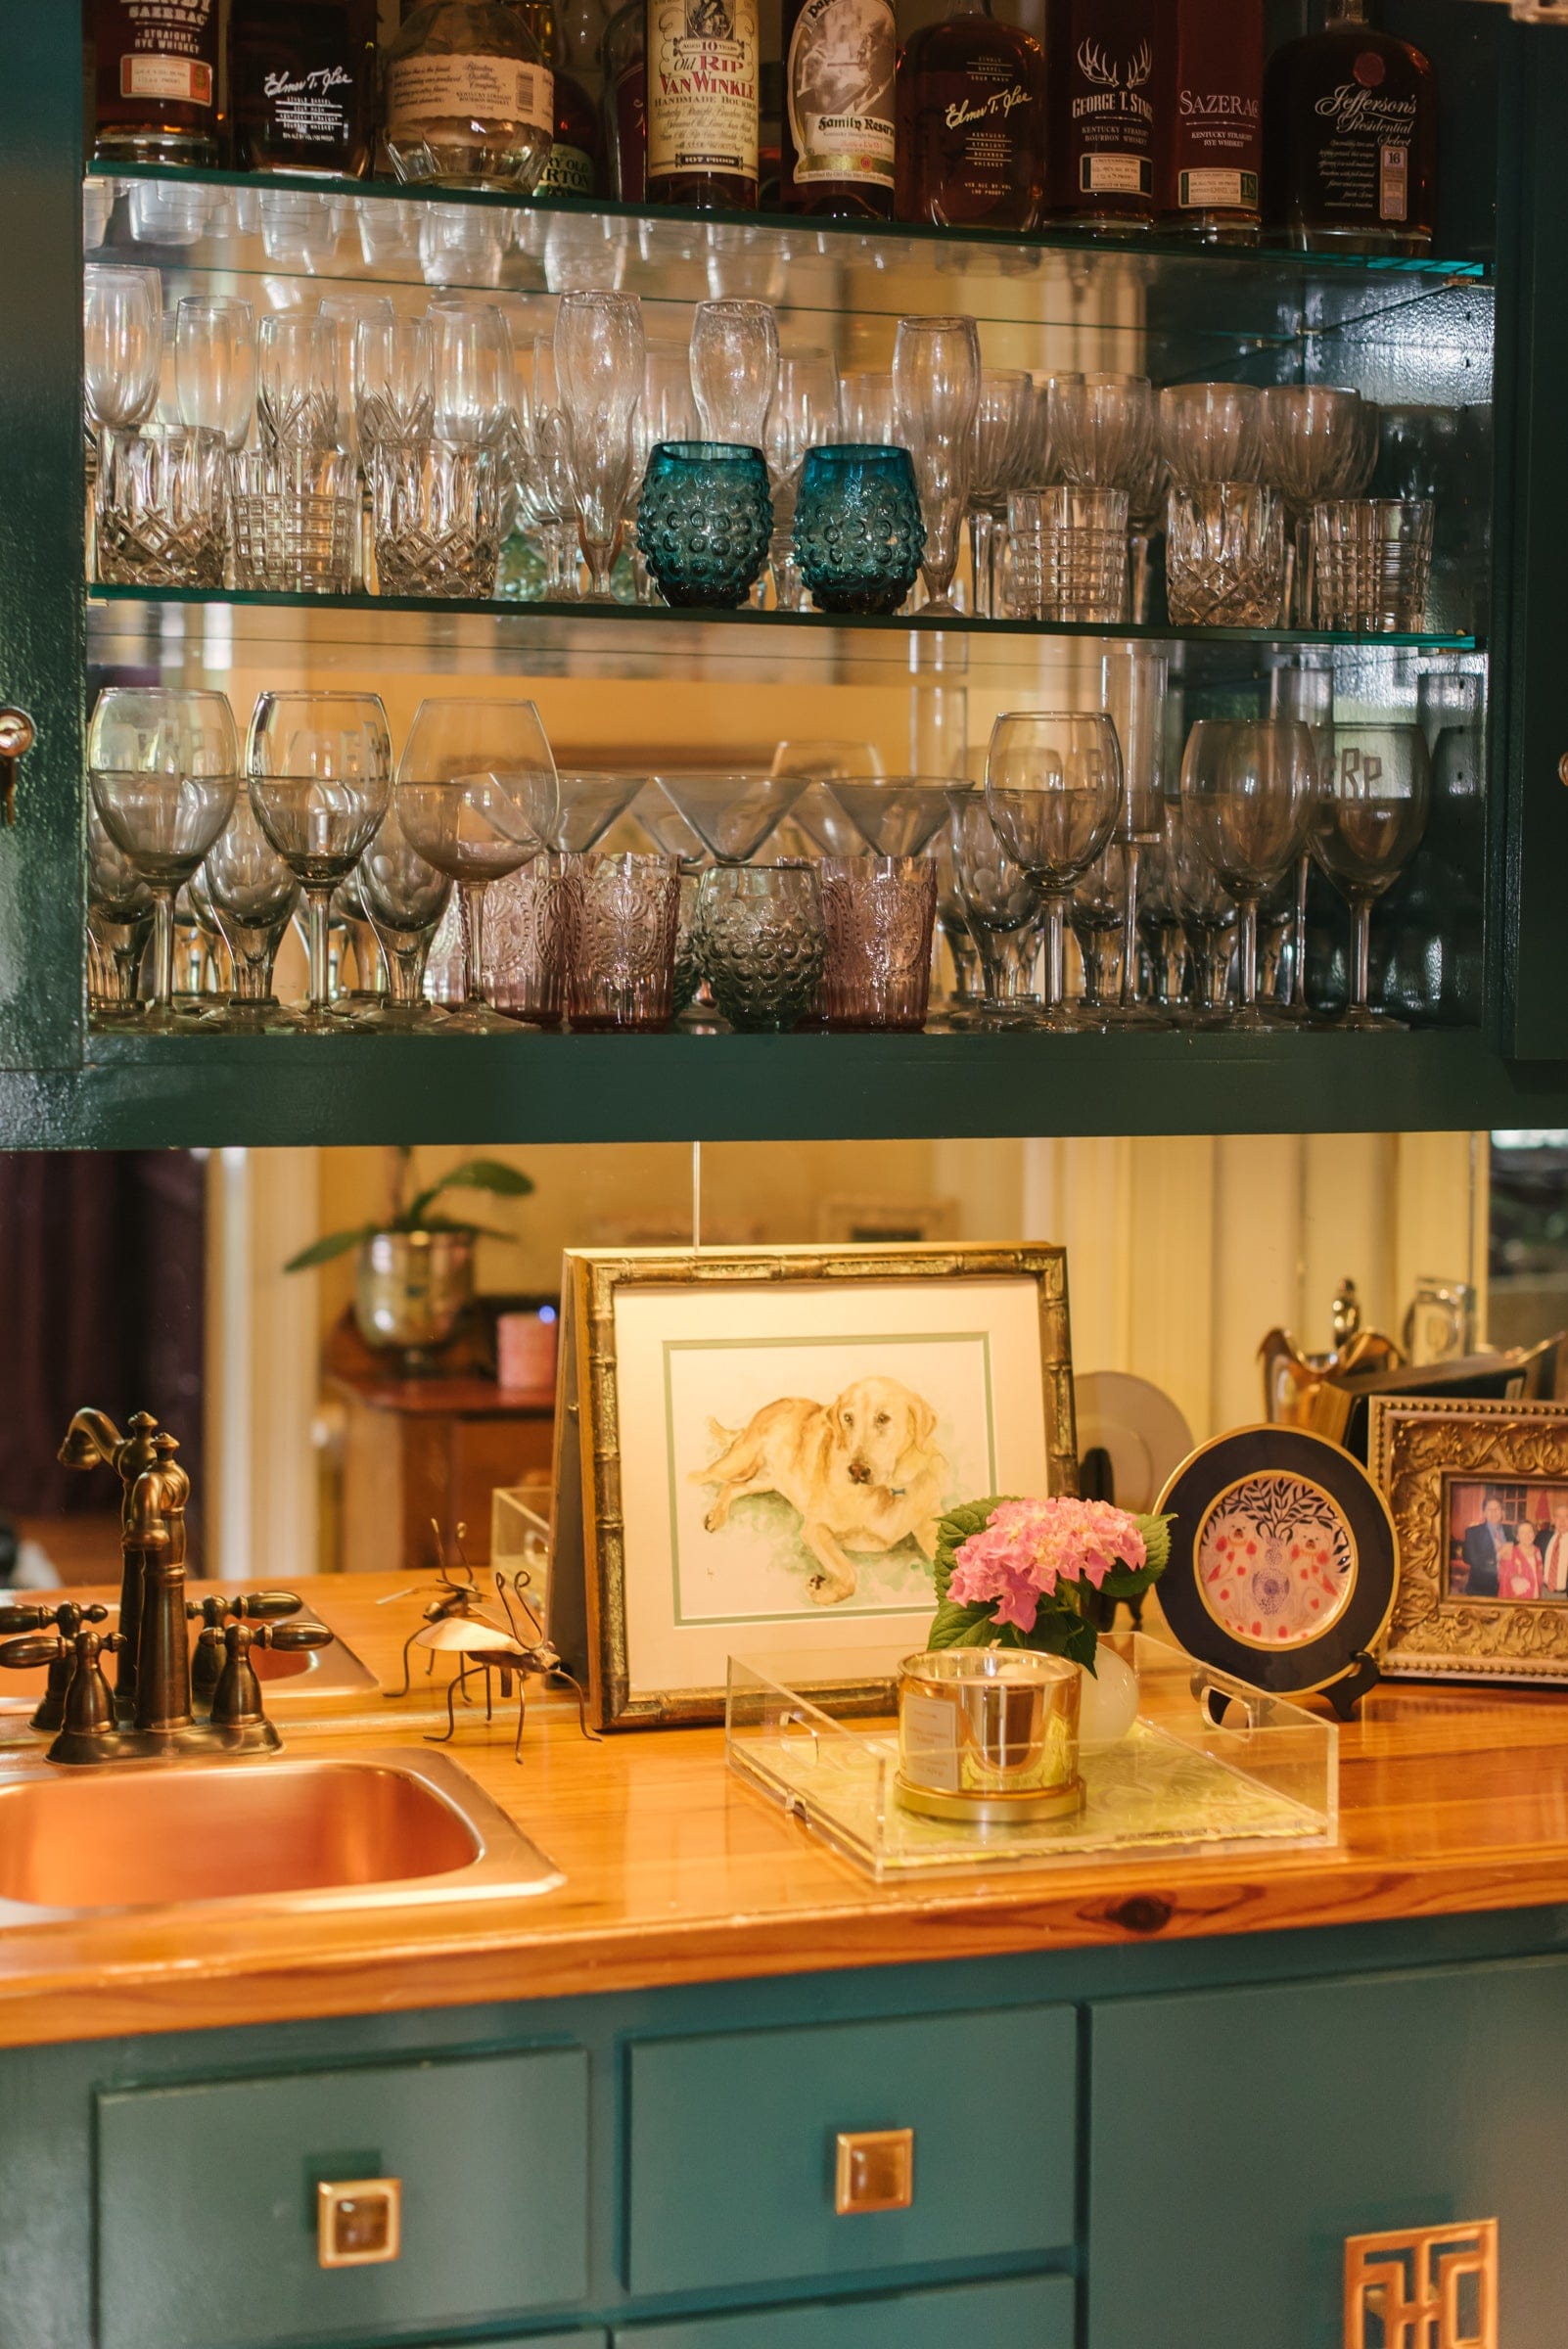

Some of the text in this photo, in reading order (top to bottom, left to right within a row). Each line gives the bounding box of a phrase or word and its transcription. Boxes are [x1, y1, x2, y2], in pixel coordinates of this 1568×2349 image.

[702, 41, 717, 52] 10
[673, 55, 744, 73] Old RIP
[660, 70, 755, 101] VAN WINKLE
[1072, 93, 1116, 118] GEORGE
[1119, 90, 1129, 111] T.
[1178, 89, 1259, 118] SAZERAC
[1314, 82, 1417, 117] Jefferson's
[818, 115, 862, 131] Family
[1335, 111, 1415, 133] Presidential
[1388, 152, 1401, 164] 16
